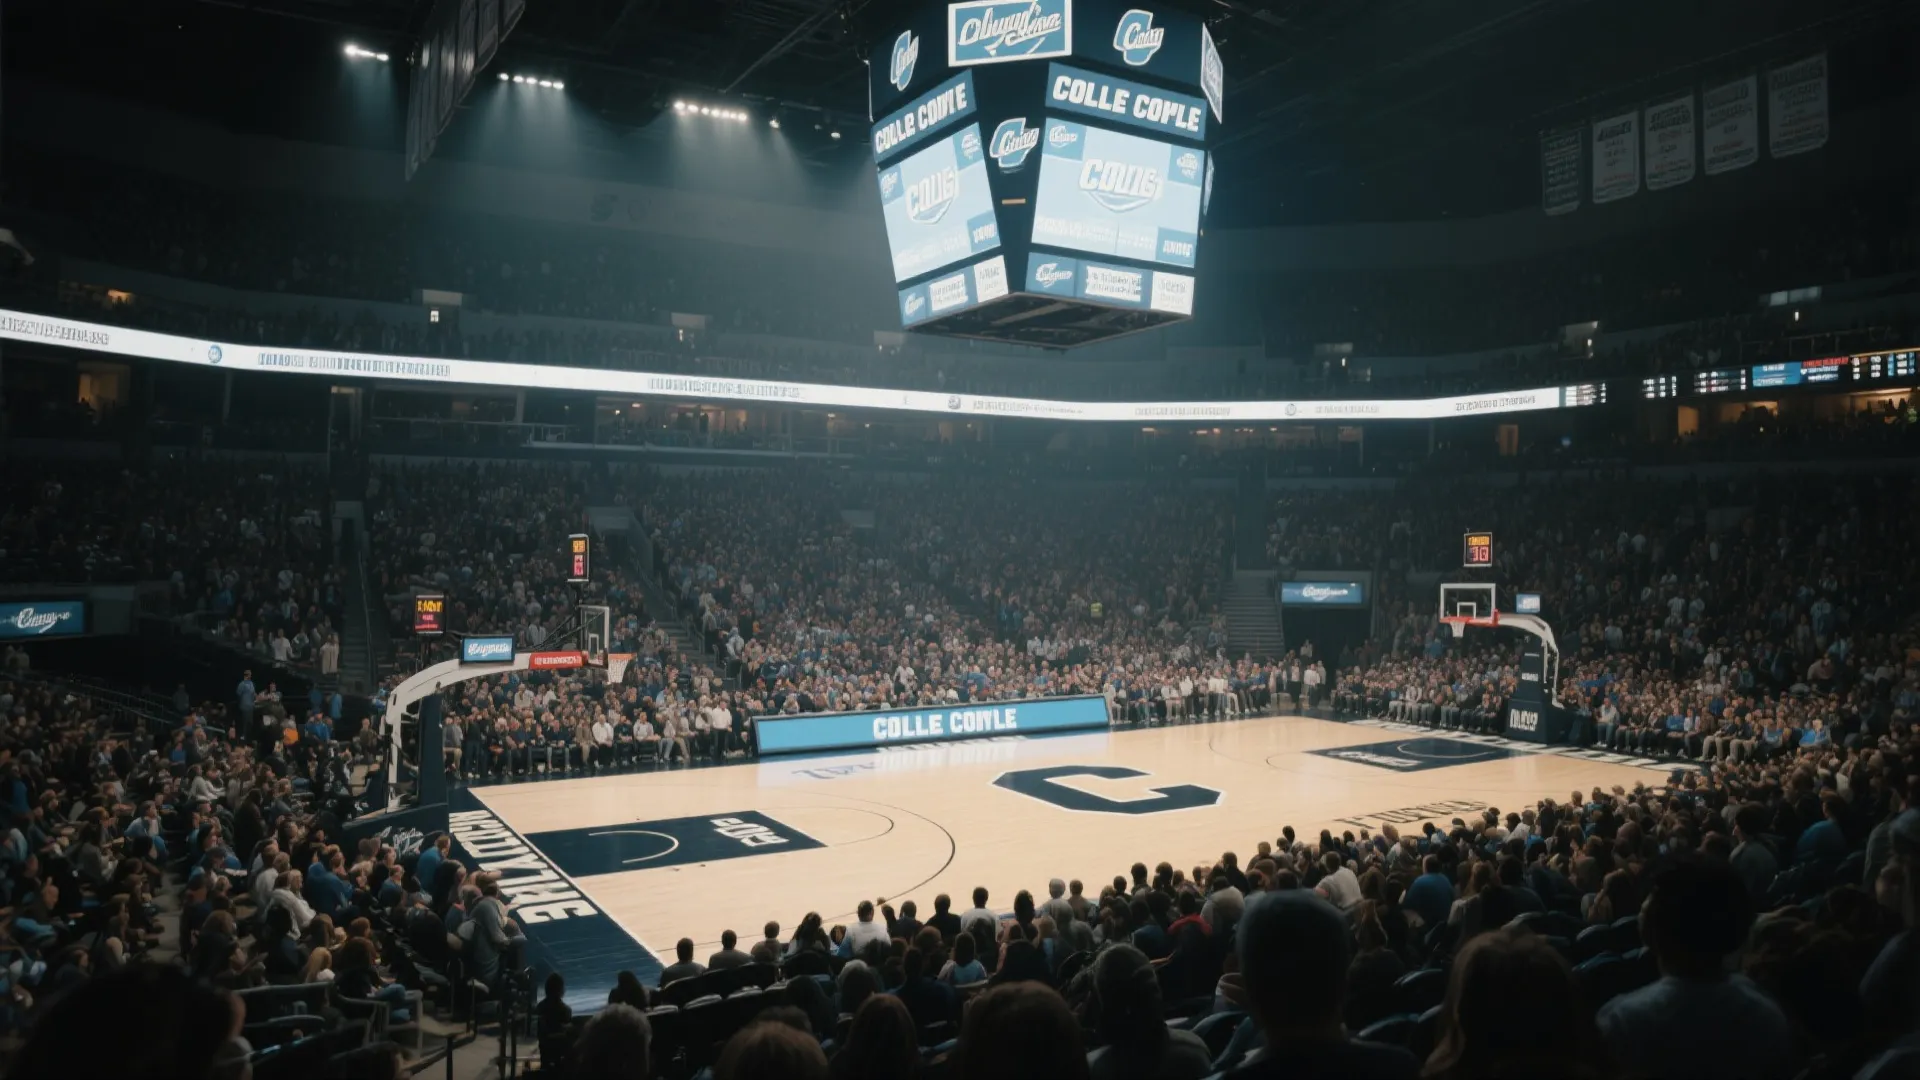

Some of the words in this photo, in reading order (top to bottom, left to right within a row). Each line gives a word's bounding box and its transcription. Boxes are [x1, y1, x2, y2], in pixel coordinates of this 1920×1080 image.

[1053, 75, 1130, 114] COLLE
[873, 713, 943, 740] COLLE
[991, 765, 1223, 815] C
